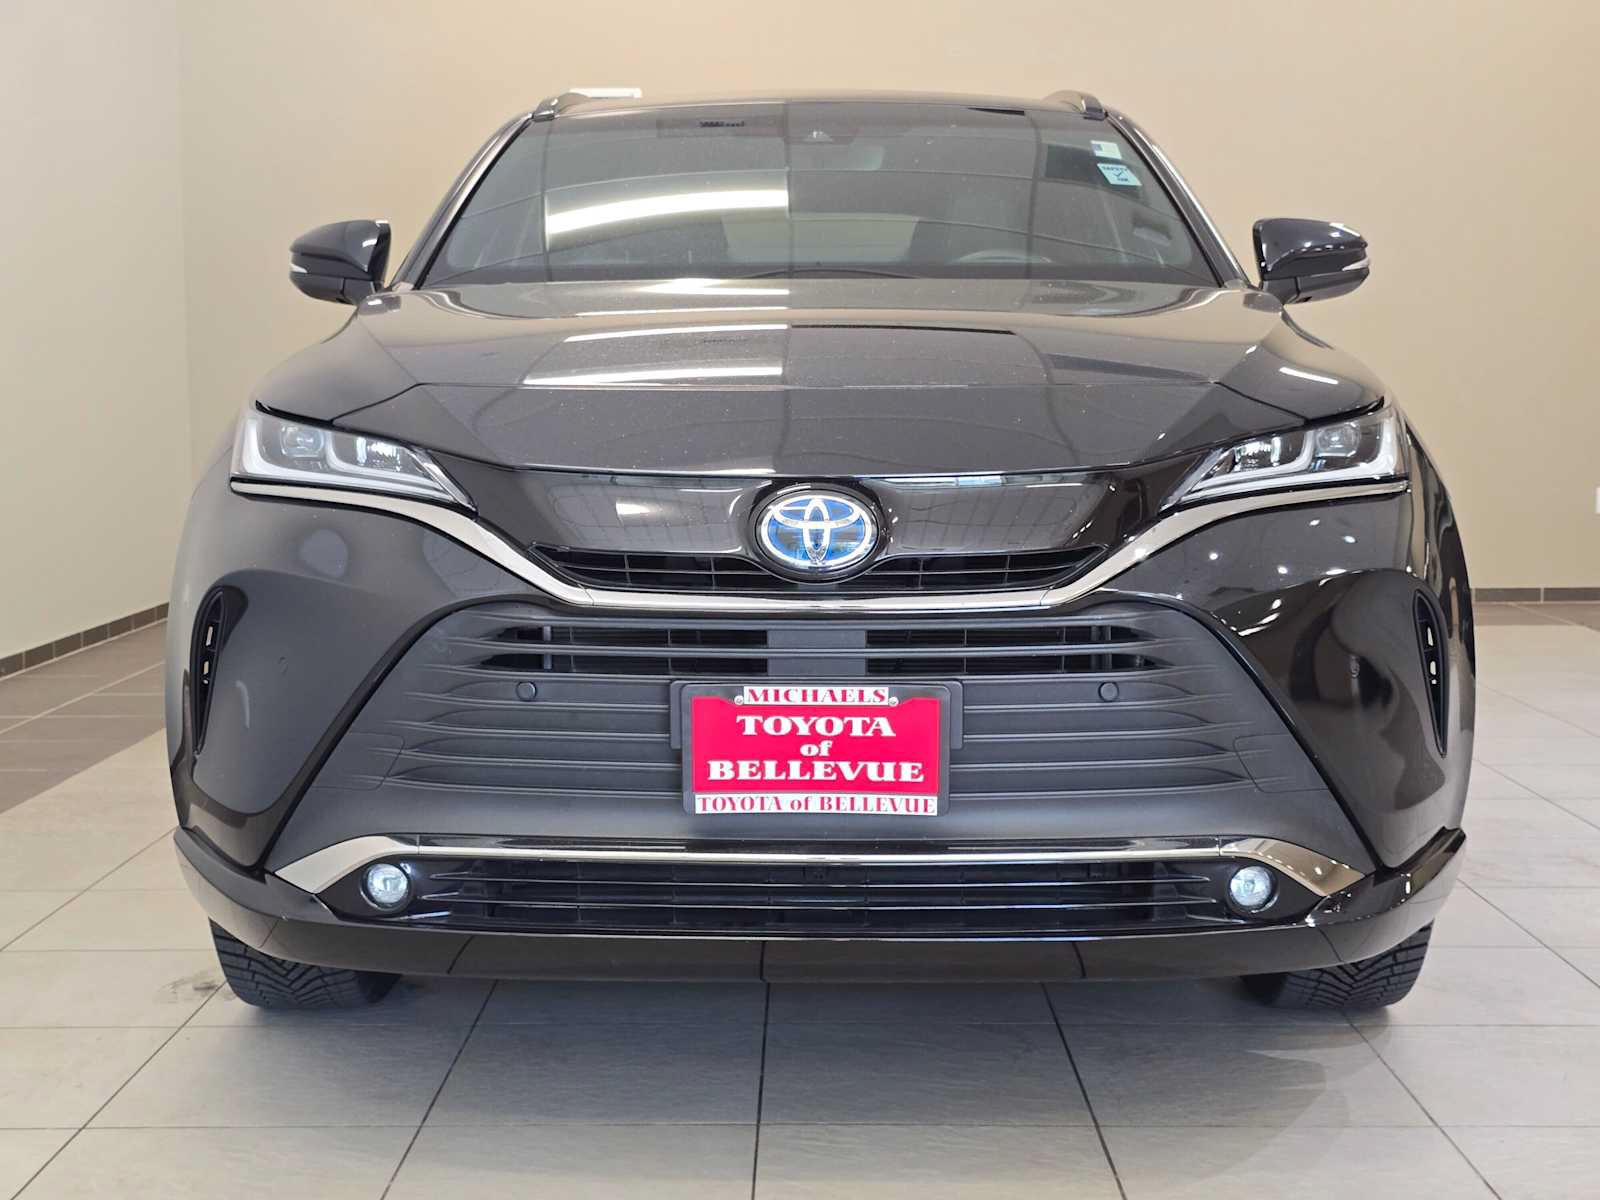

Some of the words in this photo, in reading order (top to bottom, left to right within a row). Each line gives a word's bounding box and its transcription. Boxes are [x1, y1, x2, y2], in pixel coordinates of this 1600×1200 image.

[747, 688, 886, 703] MICHAELS
[736, 716, 896, 737] TOYOTA
[800, 740, 832, 757] of
[707, 760, 924, 782] BELLEVUE
[697, 797, 780, 812] TOYOTA
[790, 797, 812, 812] of
[820, 797, 936, 813] BELLEVUE
